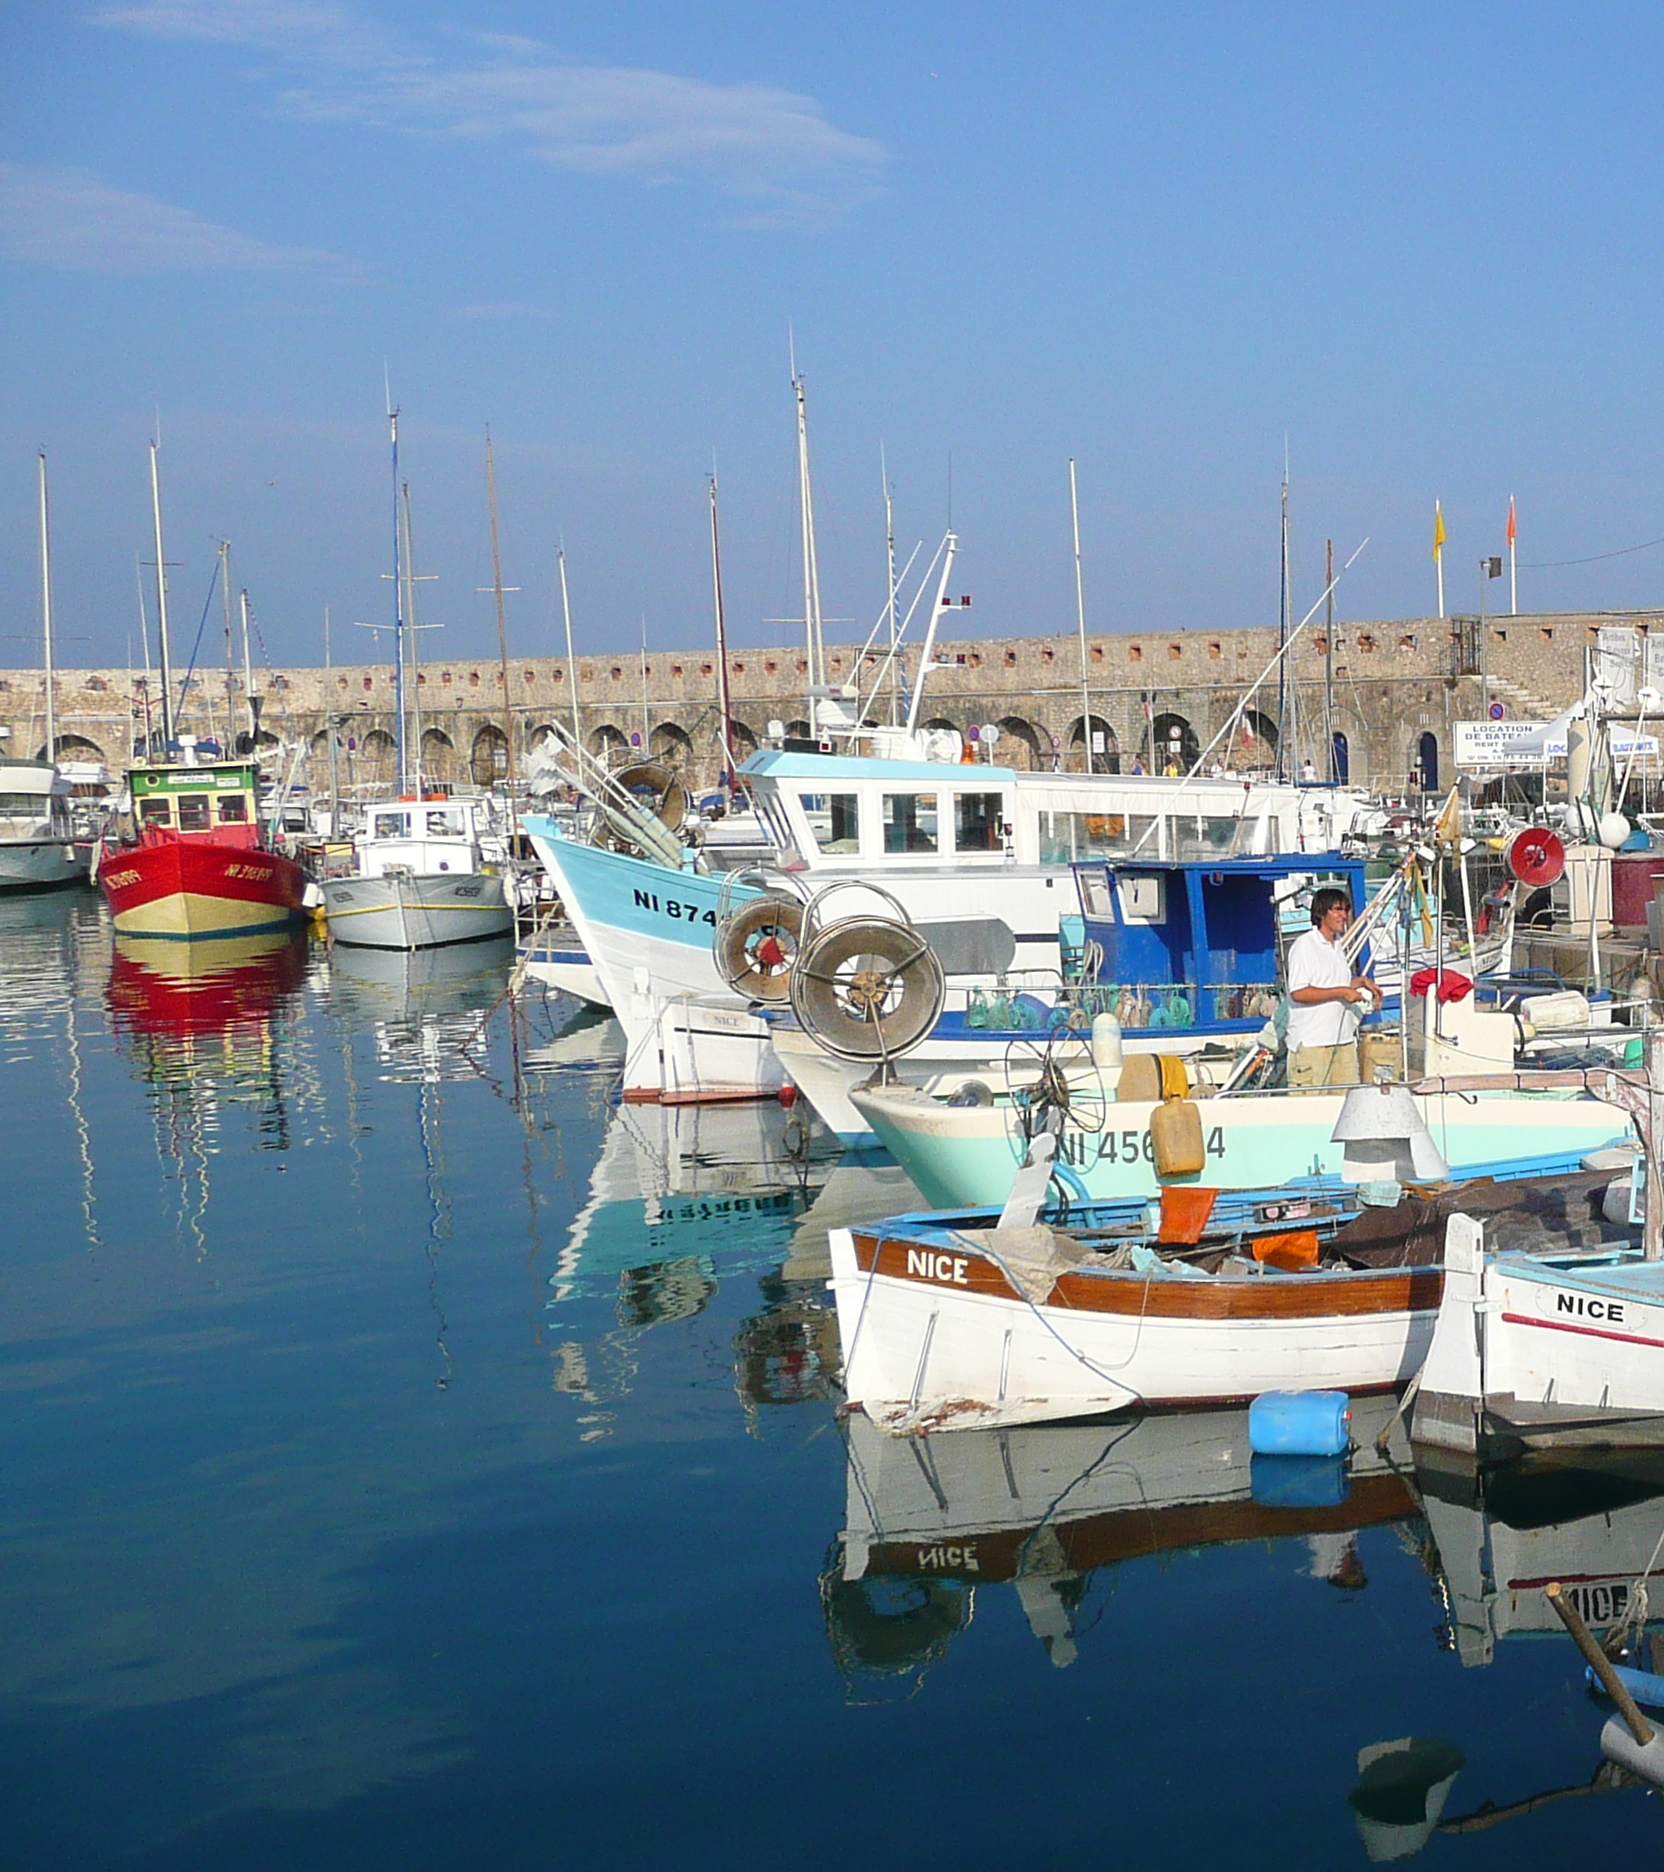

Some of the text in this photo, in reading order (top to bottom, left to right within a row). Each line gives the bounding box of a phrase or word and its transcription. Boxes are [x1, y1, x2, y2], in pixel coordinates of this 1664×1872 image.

[1473, 725, 1533, 733] LOCATION
[634, 889, 659, 912] NI
[907, 1249, 969, 1285] NICE
[1557, 1293, 1624, 1322] NICE
